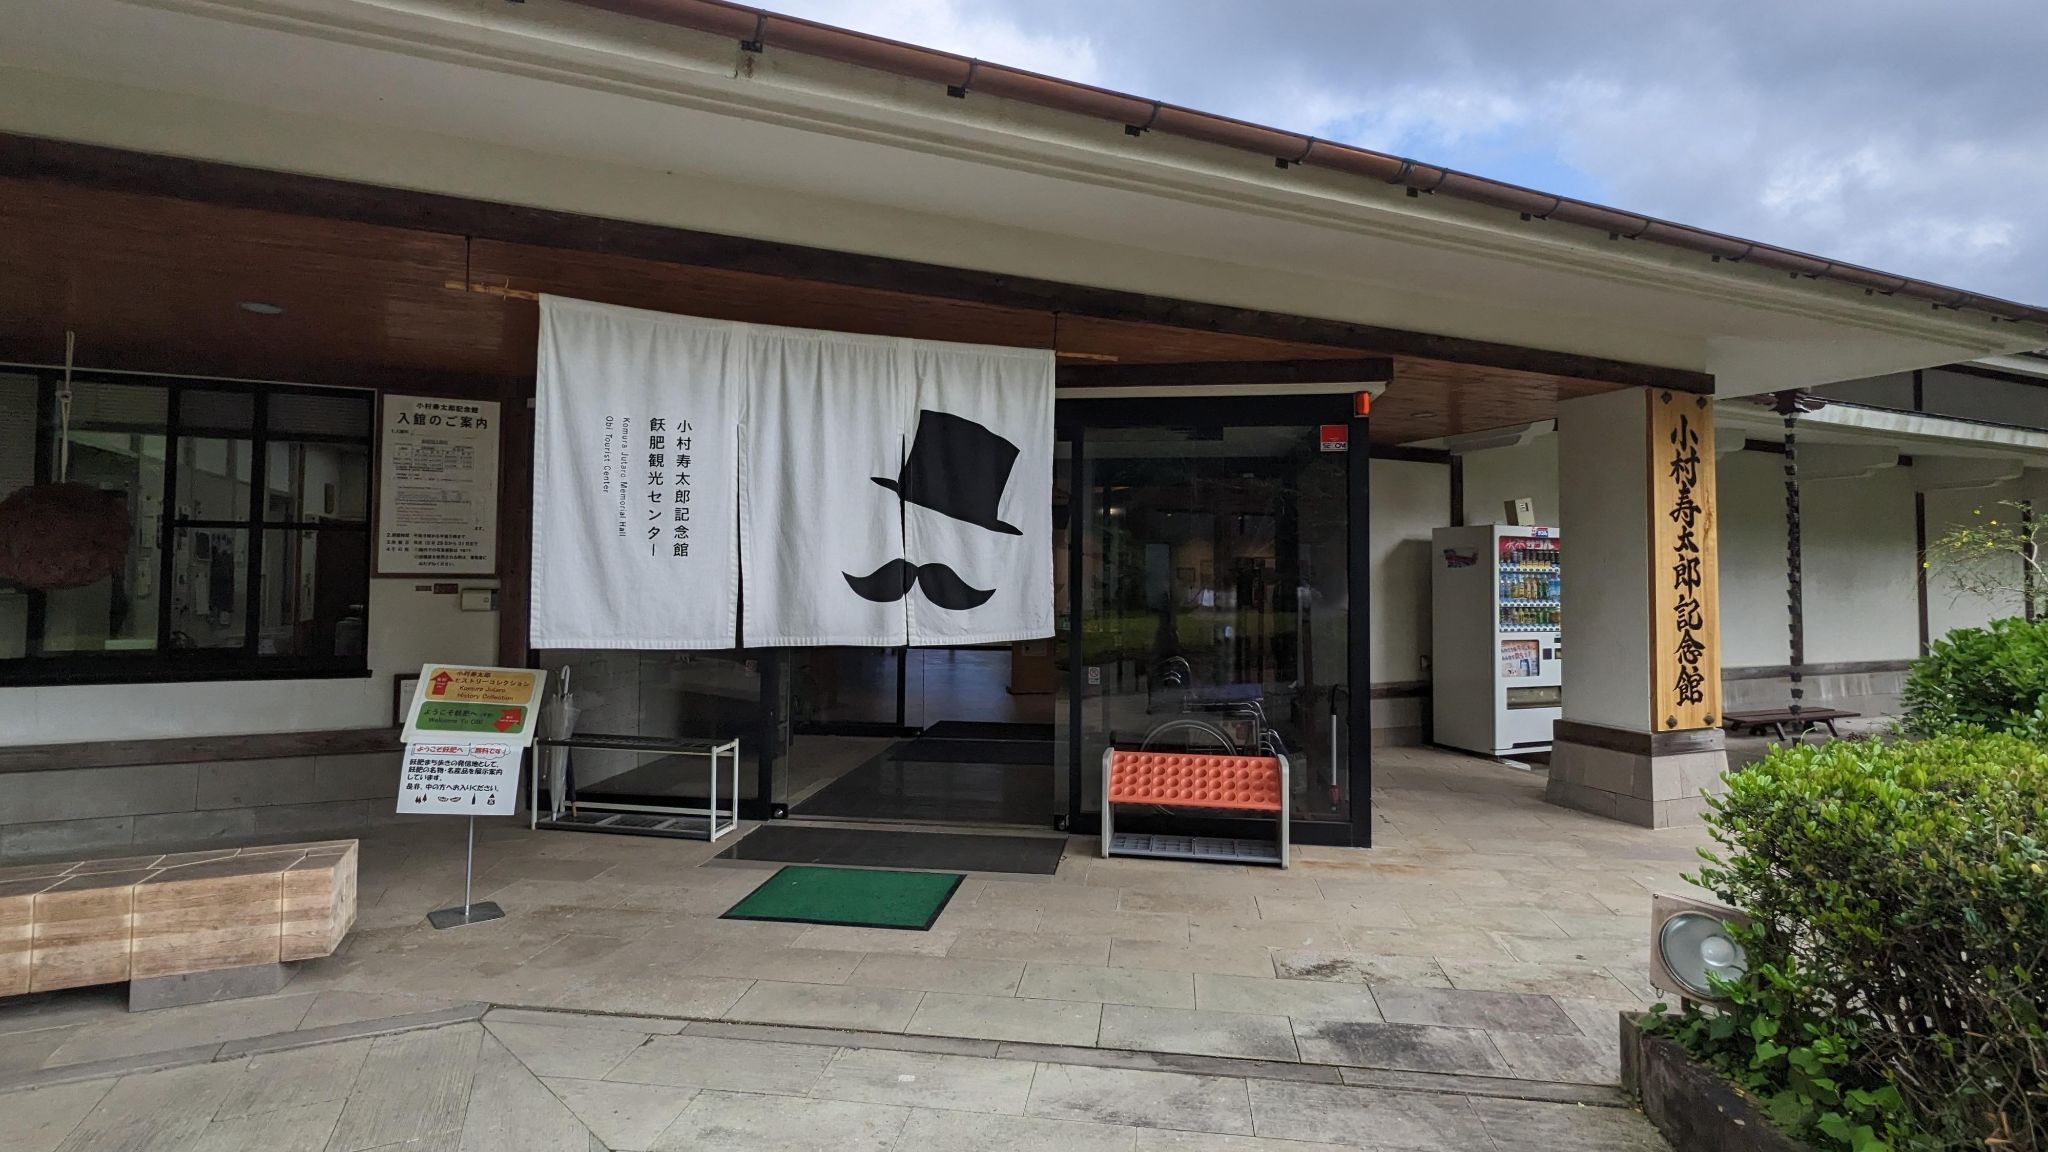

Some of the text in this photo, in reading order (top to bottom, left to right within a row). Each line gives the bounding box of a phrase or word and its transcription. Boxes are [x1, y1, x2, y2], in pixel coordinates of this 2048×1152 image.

[397, 412, 488, 430] 入館のご案内
[621, 417, 630, 448] Komura
[602, 415, 614, 493] Obi Tourist Center
[620, 451, 629, 478] Jutaro
[619, 481, 627, 519] Memorial
[648, 417, 666, 557] 飫肥観光センター
[673, 419, 692, 557] 小村寿太郎記念館
[1669, 414, 1706, 706] 小村寿太郎記念館
[455, 678, 530, 687] ヒストリーコレクション
